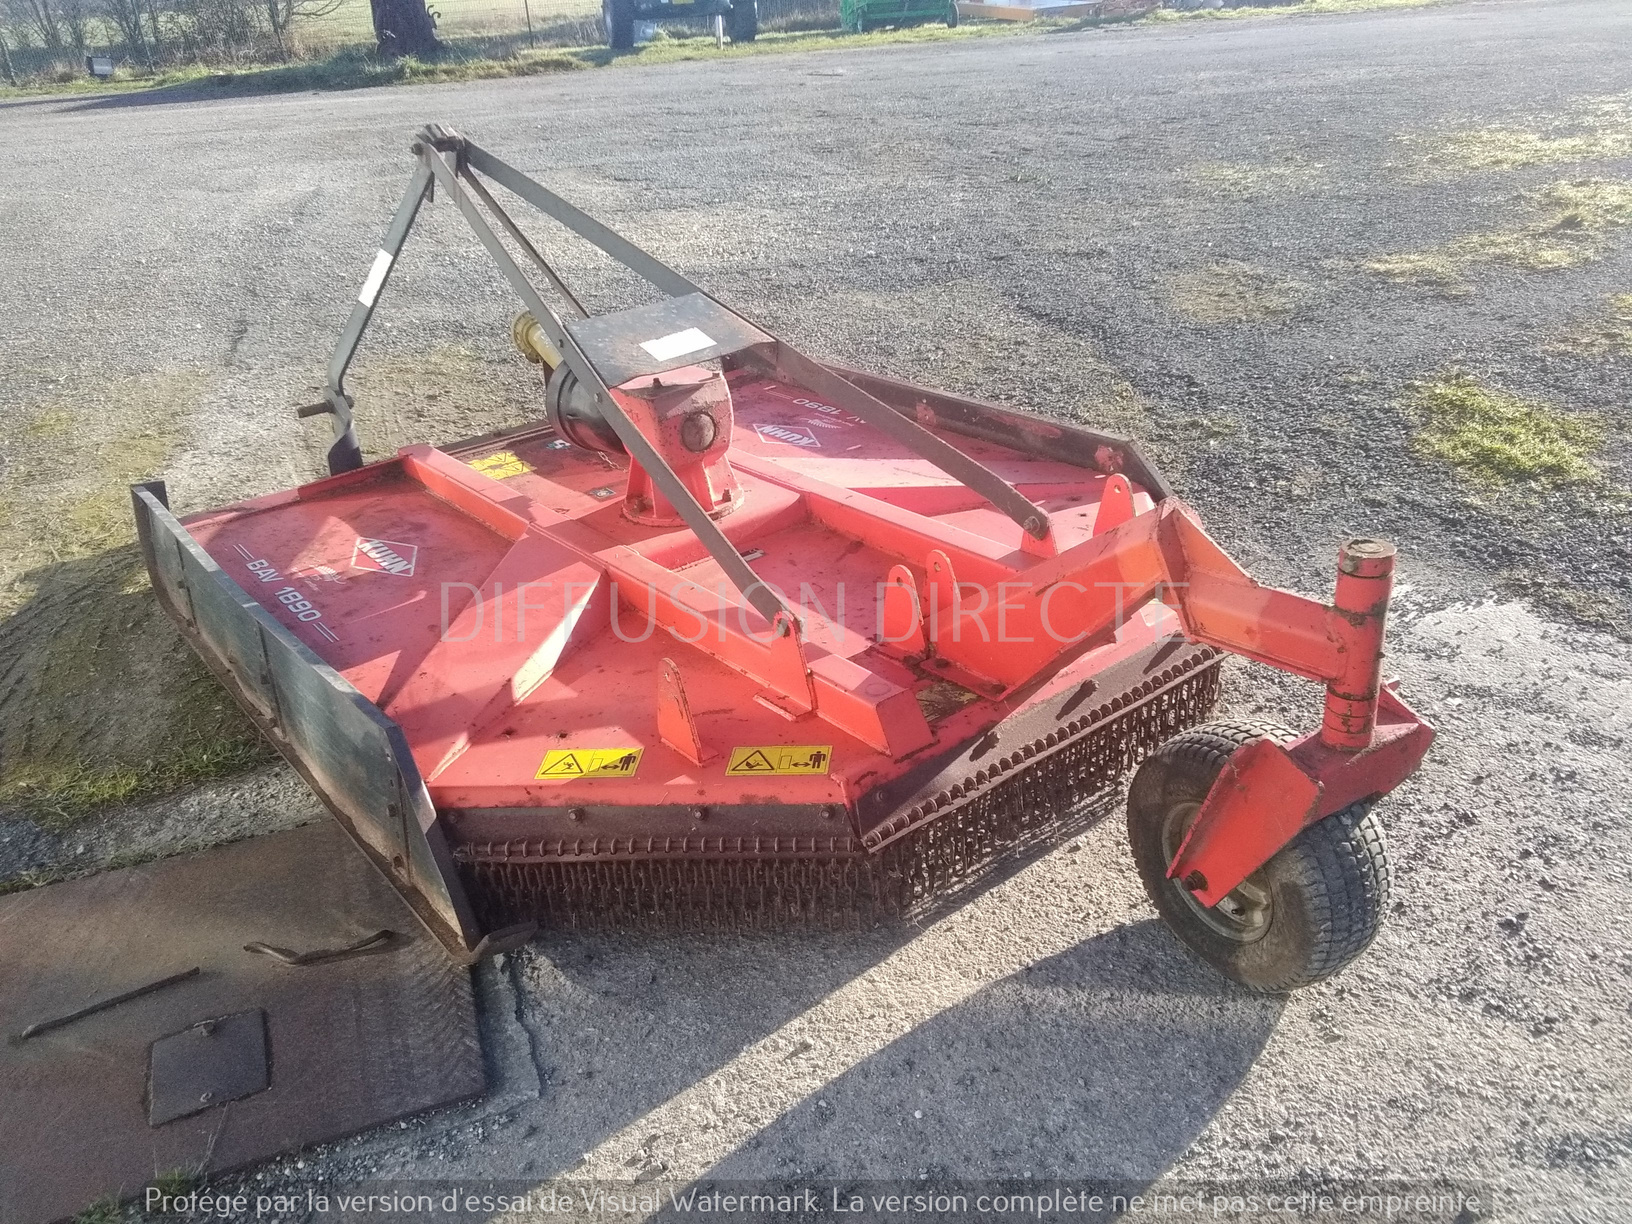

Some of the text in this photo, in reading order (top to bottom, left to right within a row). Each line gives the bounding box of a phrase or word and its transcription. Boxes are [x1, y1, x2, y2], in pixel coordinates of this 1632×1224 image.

[792, 398, 842, 415] 1890
[758, 425, 815, 446] KUHN
[358, 540, 413, 574] KUHN
[246, 559, 284, 583] BAV
[274, 586, 322, 622] 1890
